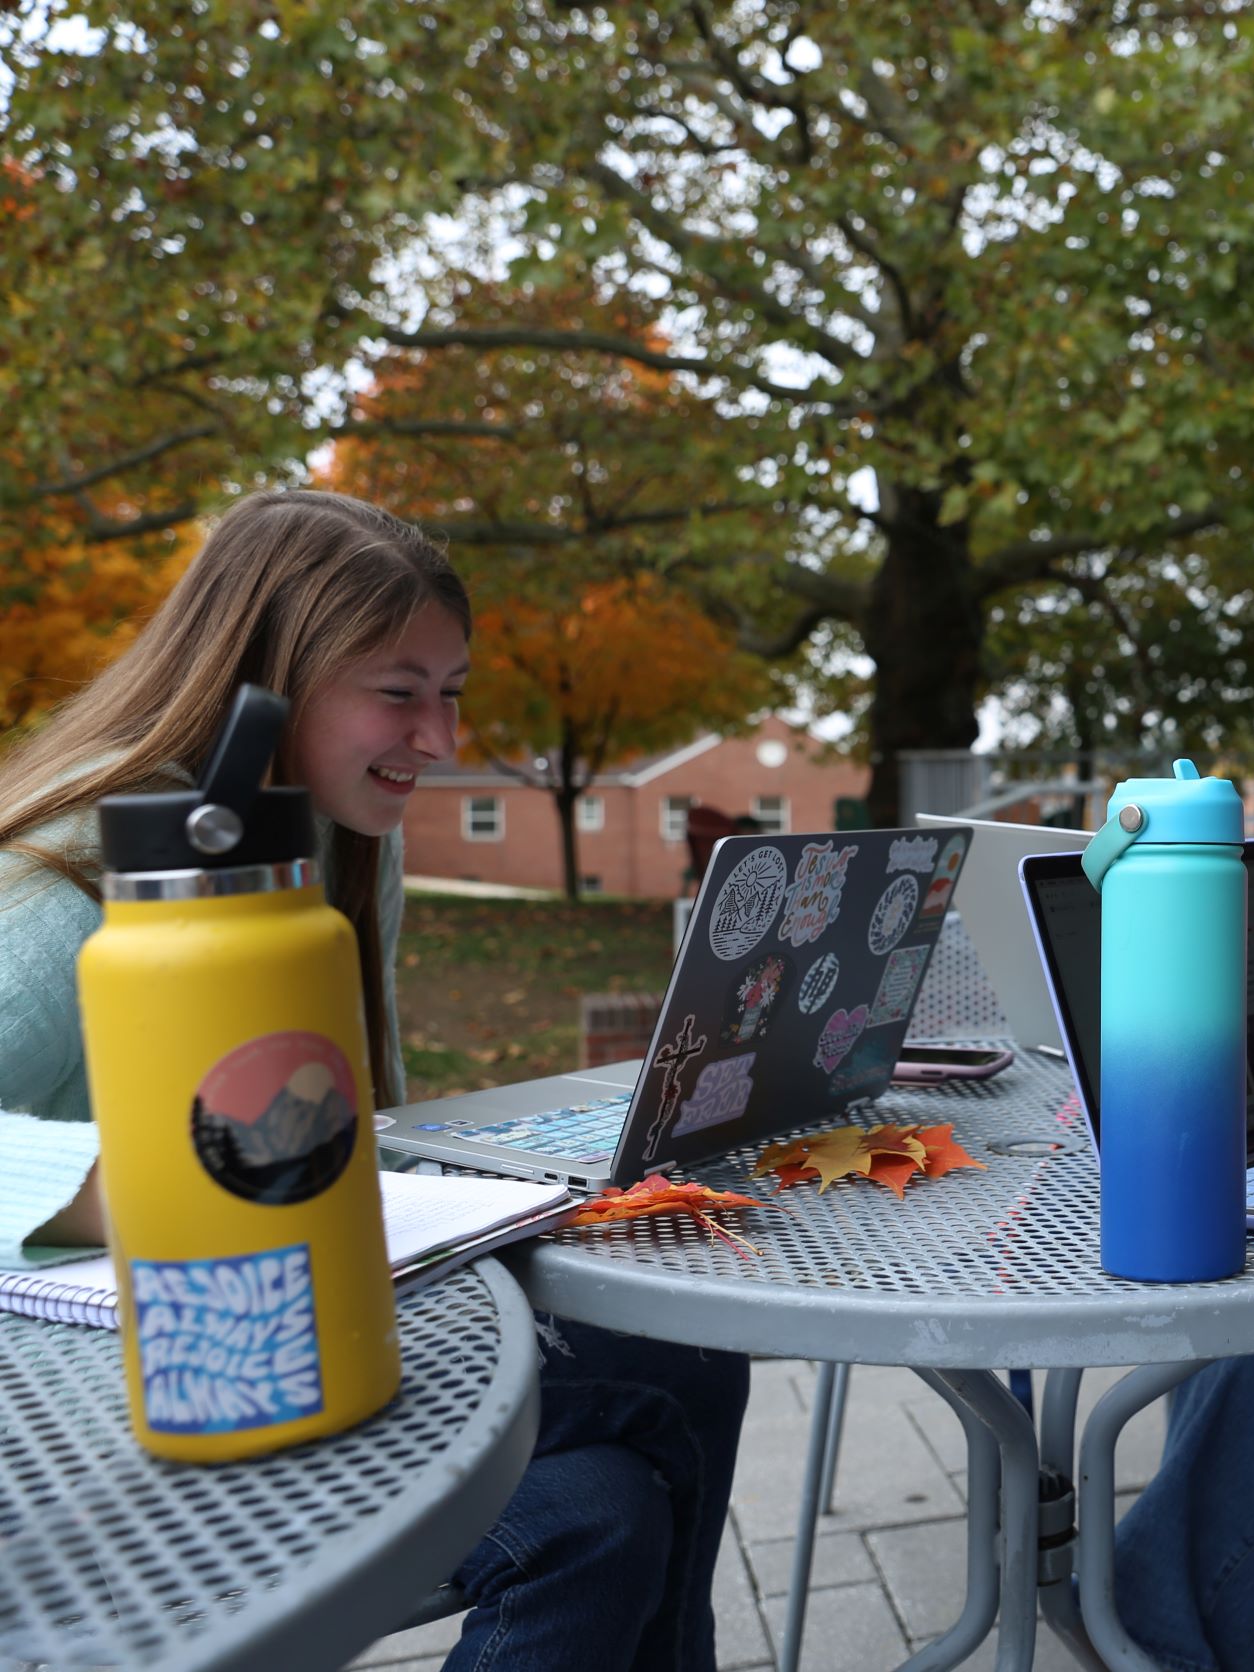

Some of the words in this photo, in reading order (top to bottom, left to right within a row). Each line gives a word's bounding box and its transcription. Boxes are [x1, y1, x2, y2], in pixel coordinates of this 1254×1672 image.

[733, 853, 755, 878] LET'S
[758, 850, 773, 859] GET
[772, 854, 784, 873] LOST
[691, 1055, 755, 1100] SET
[675, 1079, 751, 1130] FREE
[134, 1252, 311, 1315] REJOICE
[142, 1295, 313, 1351] ALWAYS
[144, 1333, 317, 1379] REJOICE
[148, 1369, 321, 1424] ALWAYS
